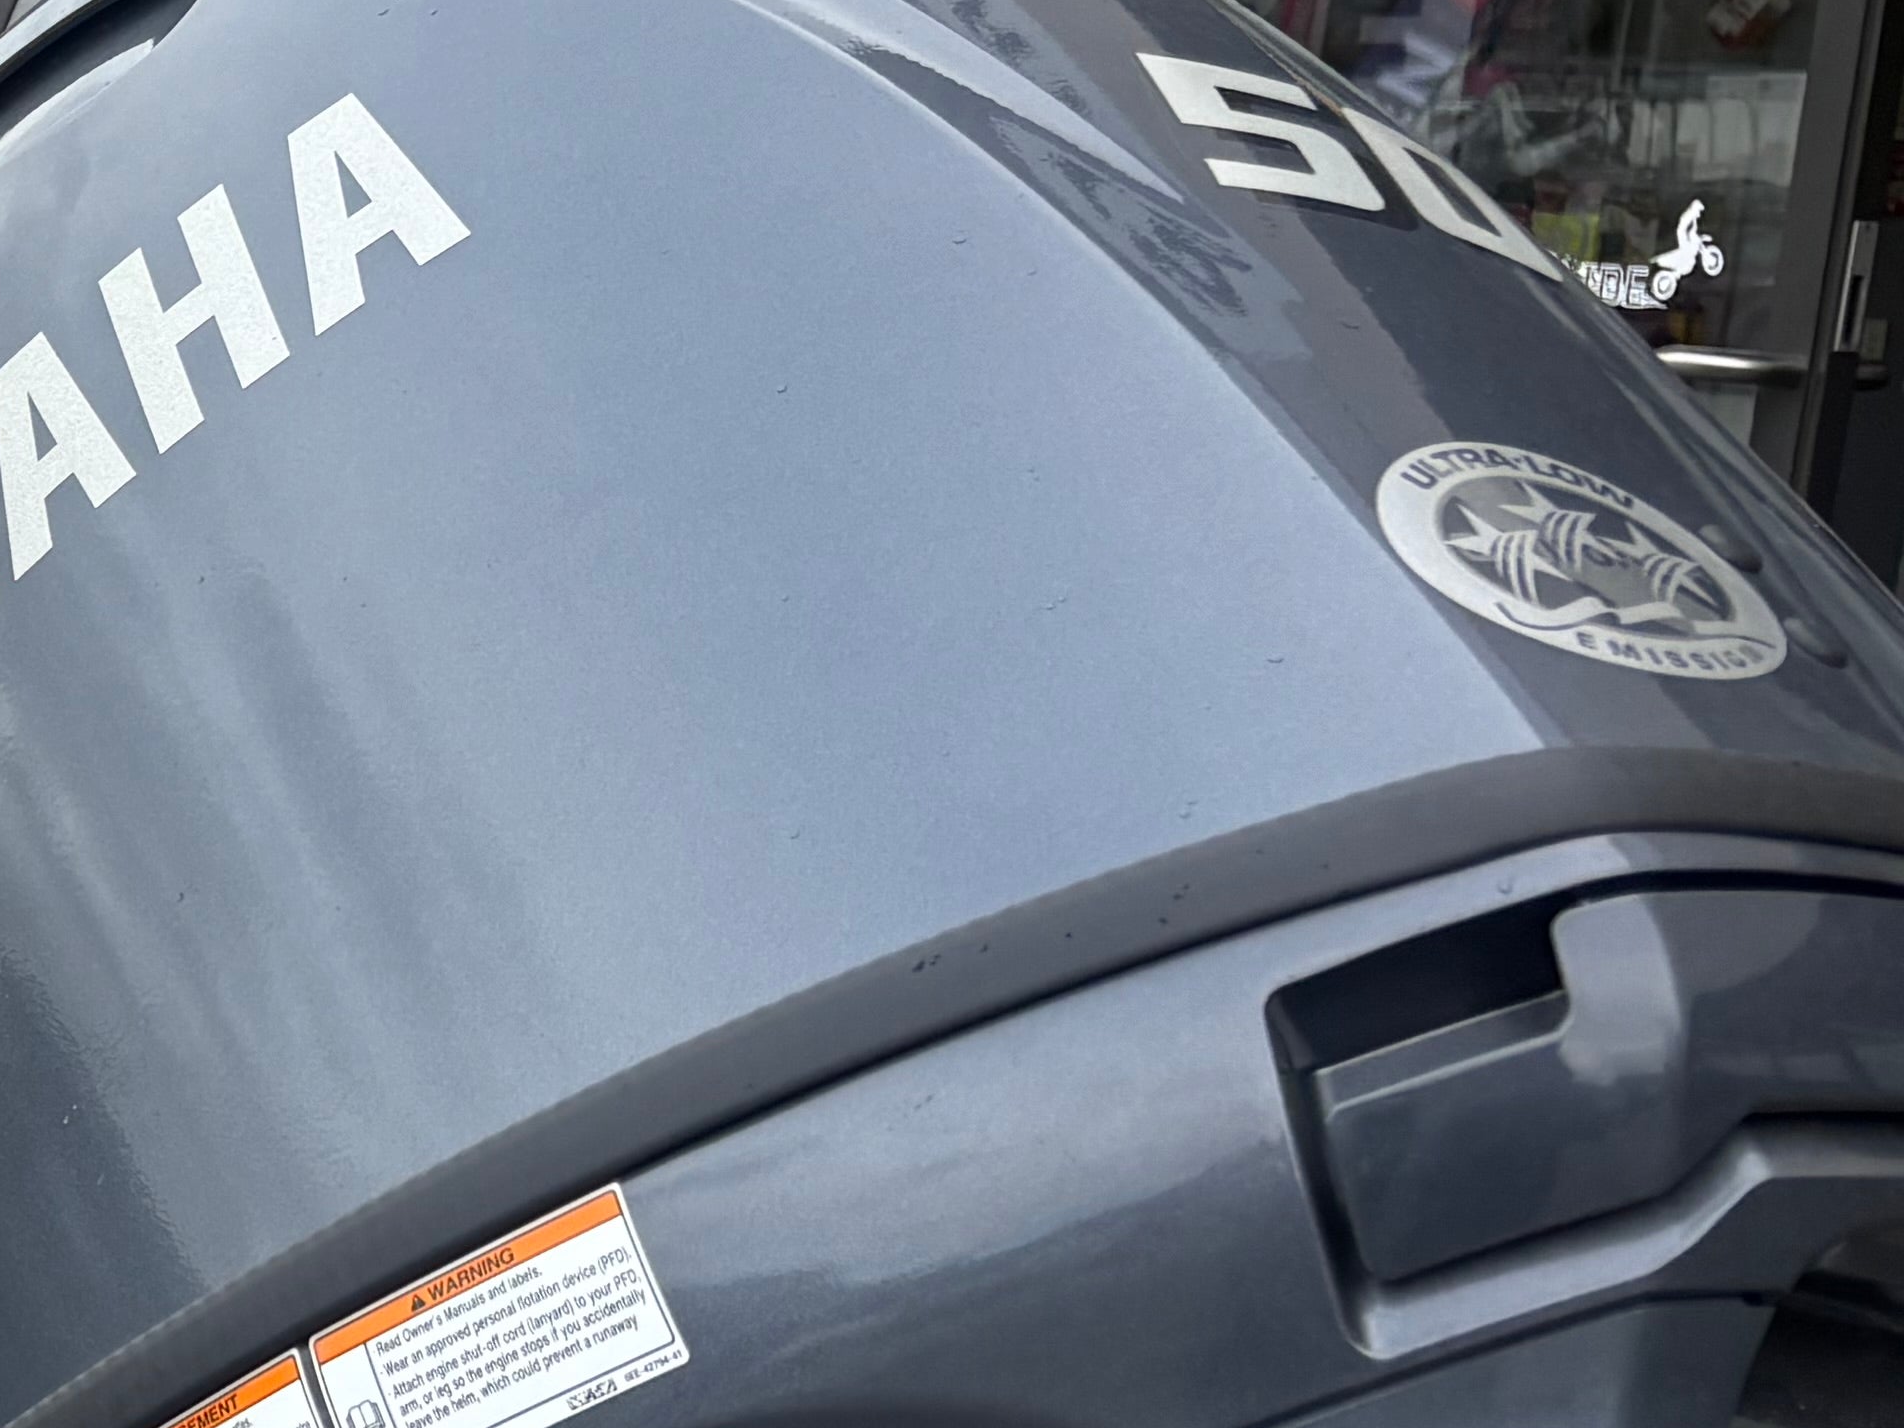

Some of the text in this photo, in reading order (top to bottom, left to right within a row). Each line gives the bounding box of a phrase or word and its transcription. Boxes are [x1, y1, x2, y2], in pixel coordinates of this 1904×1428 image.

[1400, 447, 1634, 509] ULTRA-LOW
[1574, 631, 1763, 673] EMISSION
[376, 1267, 542, 1356] Read Owner's Manuals and labels.
[383, 1247, 632, 1377] Wear an approved personal flotation device (PFD).
[427, 1248, 514, 1301] WARNING
[393, 1269, 641, 1399] Attach engine shut-off cord (lanyard) to your PFD,
[400, 1290, 646, 1417] arm, or leg so the engine stops if you accidentally
[432, 1405, 450, 1421] the
[450, 1392, 481, 1412] helm,
[480, 1375, 511, 1397] which
[512, 1358, 542, 1383] could
[542, 1339, 583, 1372] prevent
[584, 1337, 592, 1349] a
[592, 1315, 638, 1344] runaway
